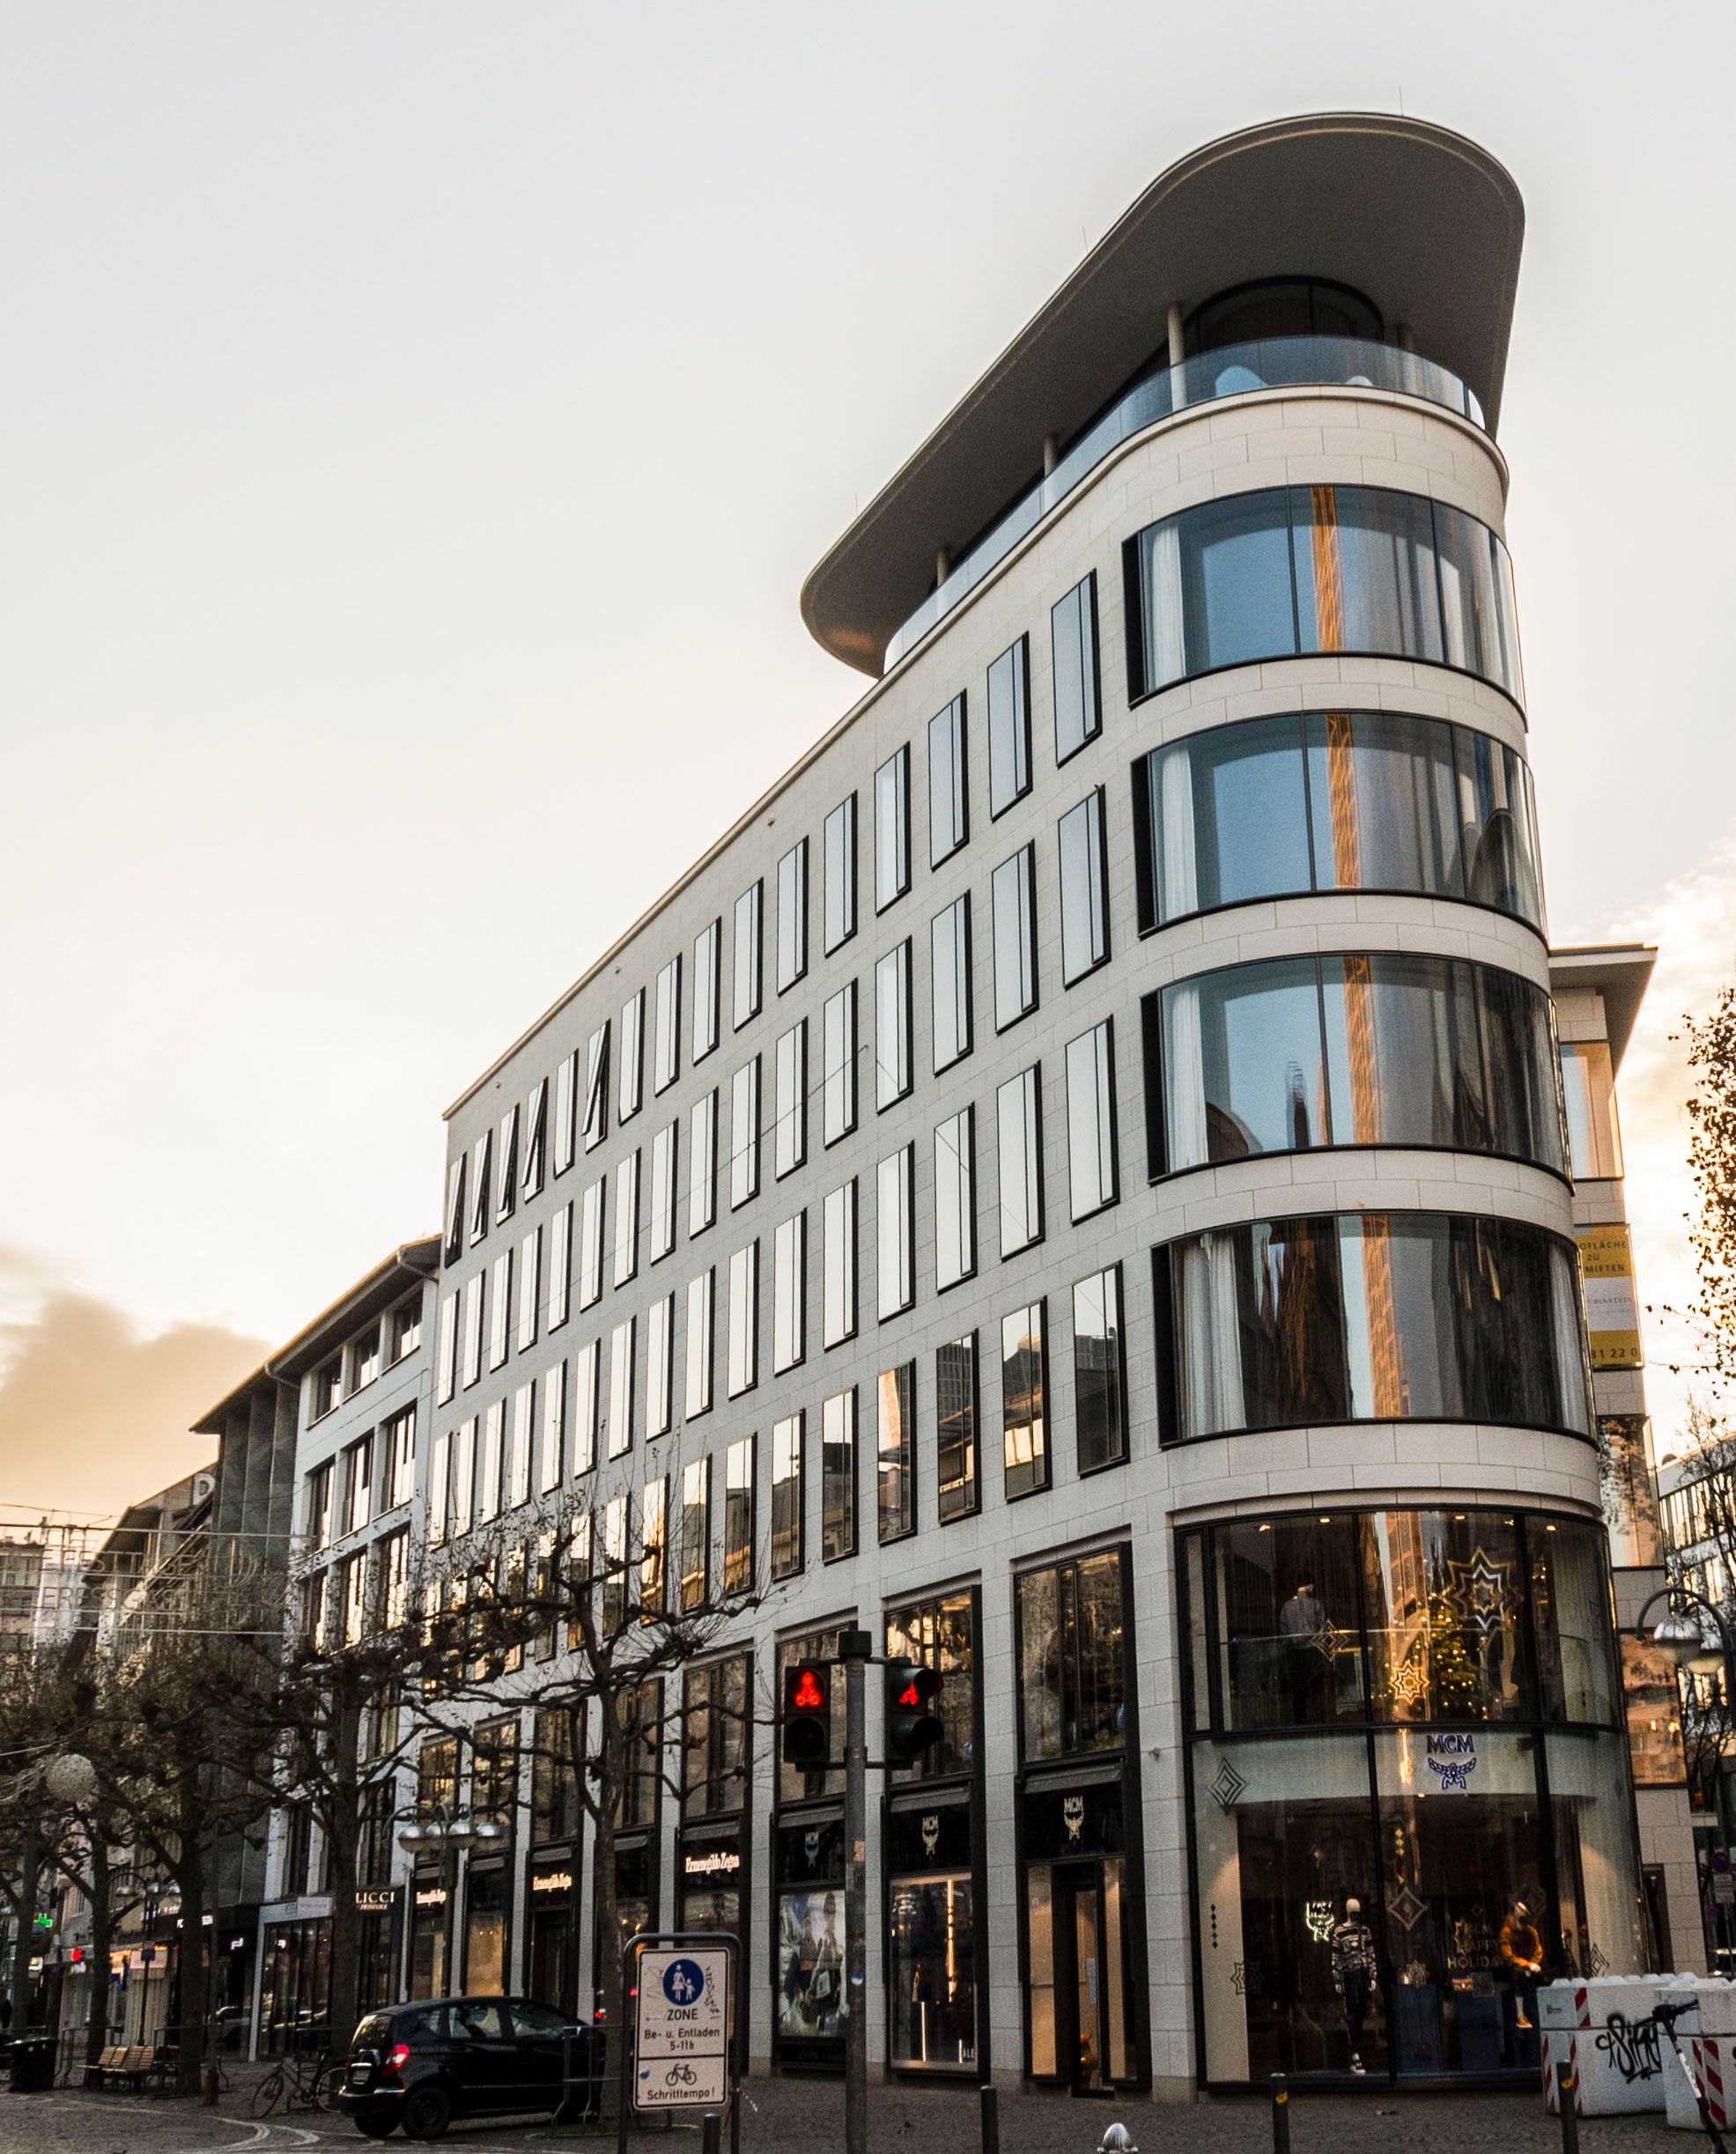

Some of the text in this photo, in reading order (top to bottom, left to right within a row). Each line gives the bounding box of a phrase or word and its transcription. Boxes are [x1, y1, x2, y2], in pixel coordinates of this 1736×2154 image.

[1586, 1253, 1600, 1262] ZU
[1610, 1347, 1626, 1359] 22
[1426, 1734, 1475, 1754] MCM
[1063, 1796, 1084, 1812] MCM
[922, 1815, 940, 1830] MCM
[805, 1831, 819, 1845] MCM
[667, 2008, 699, 2021] ZONE
[644, 2028, 662, 2040] Be-
[678, 2027, 720, 2039] Entladen
